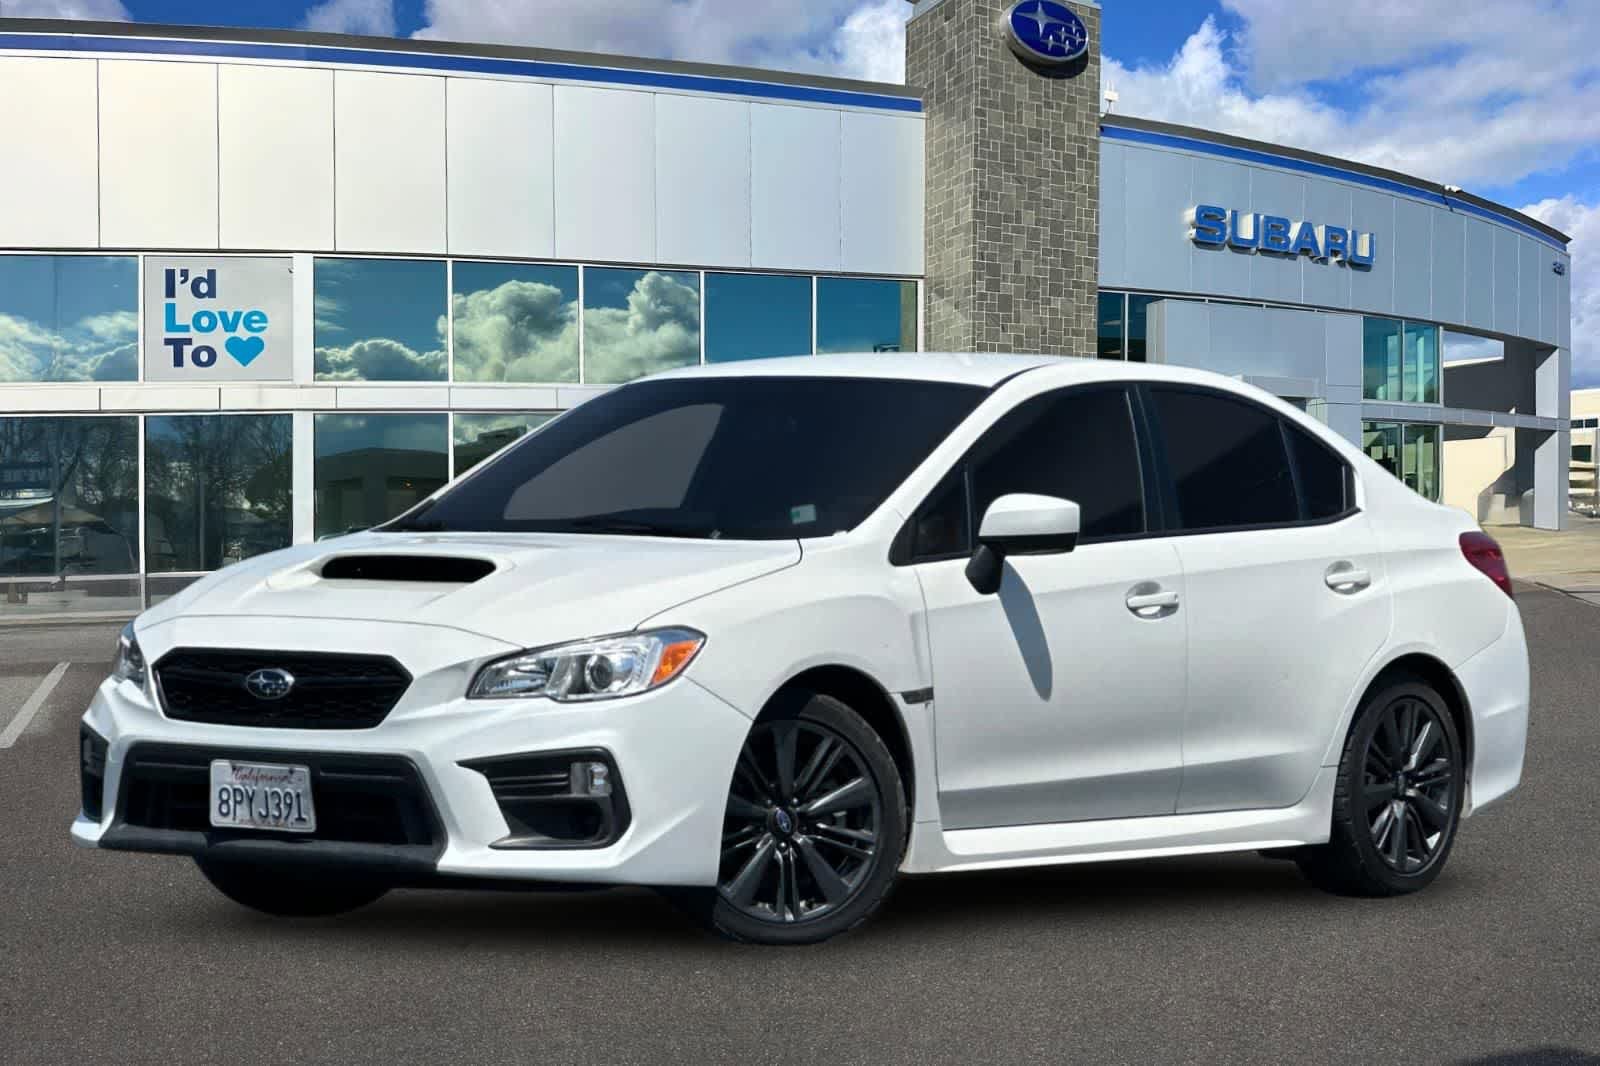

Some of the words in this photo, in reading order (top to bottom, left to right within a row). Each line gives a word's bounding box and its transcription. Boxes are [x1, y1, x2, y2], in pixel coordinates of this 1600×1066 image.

[1193, 204, 1376, 269] SUBARU
[164, 268, 217, 299] I’d
[164, 302, 268, 333] Love
[164, 337, 217, 368] To
[218, 786, 308, 822] 8PYJ391
